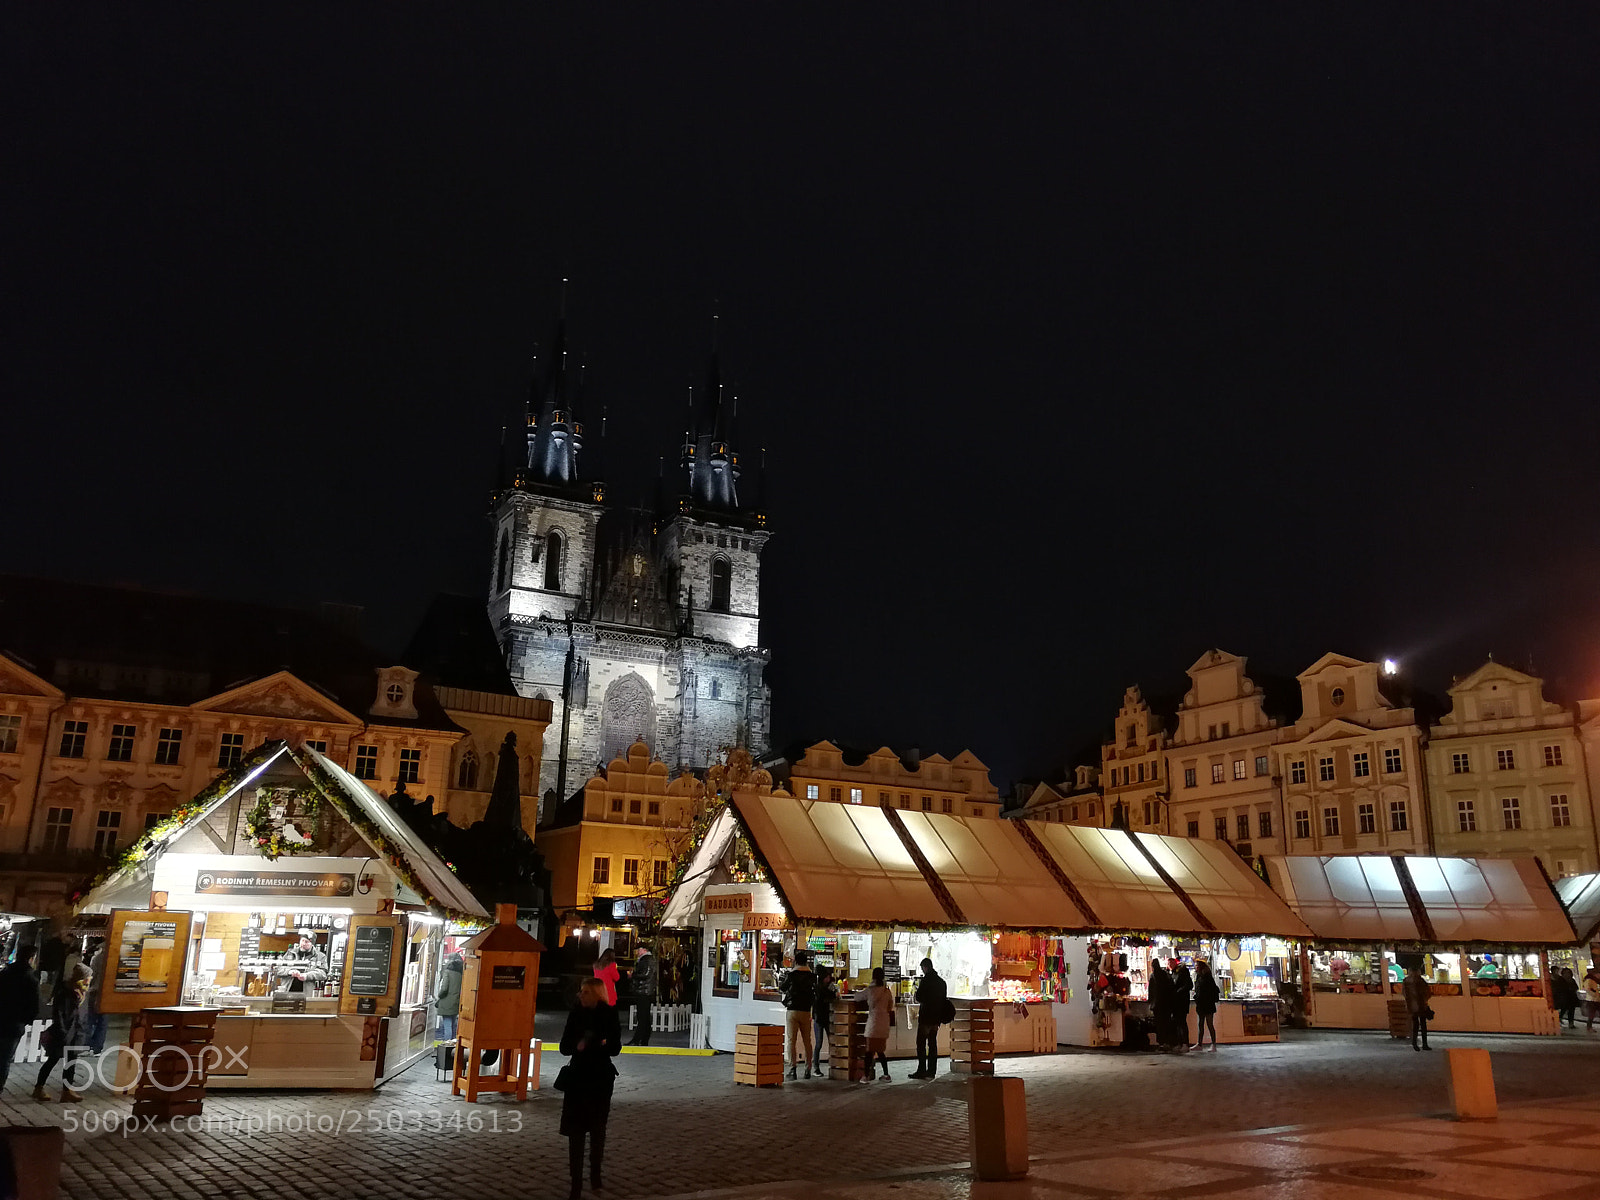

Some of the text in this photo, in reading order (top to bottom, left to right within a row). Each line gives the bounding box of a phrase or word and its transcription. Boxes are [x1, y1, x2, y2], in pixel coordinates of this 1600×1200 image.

[256, 878, 296, 886] ŘEMESLNÝ
[298, 879, 334, 887] PIVOVAR
[708, 898, 749, 910] SAUSAGES
[746, 915, 788, 927] KLOBÁS
